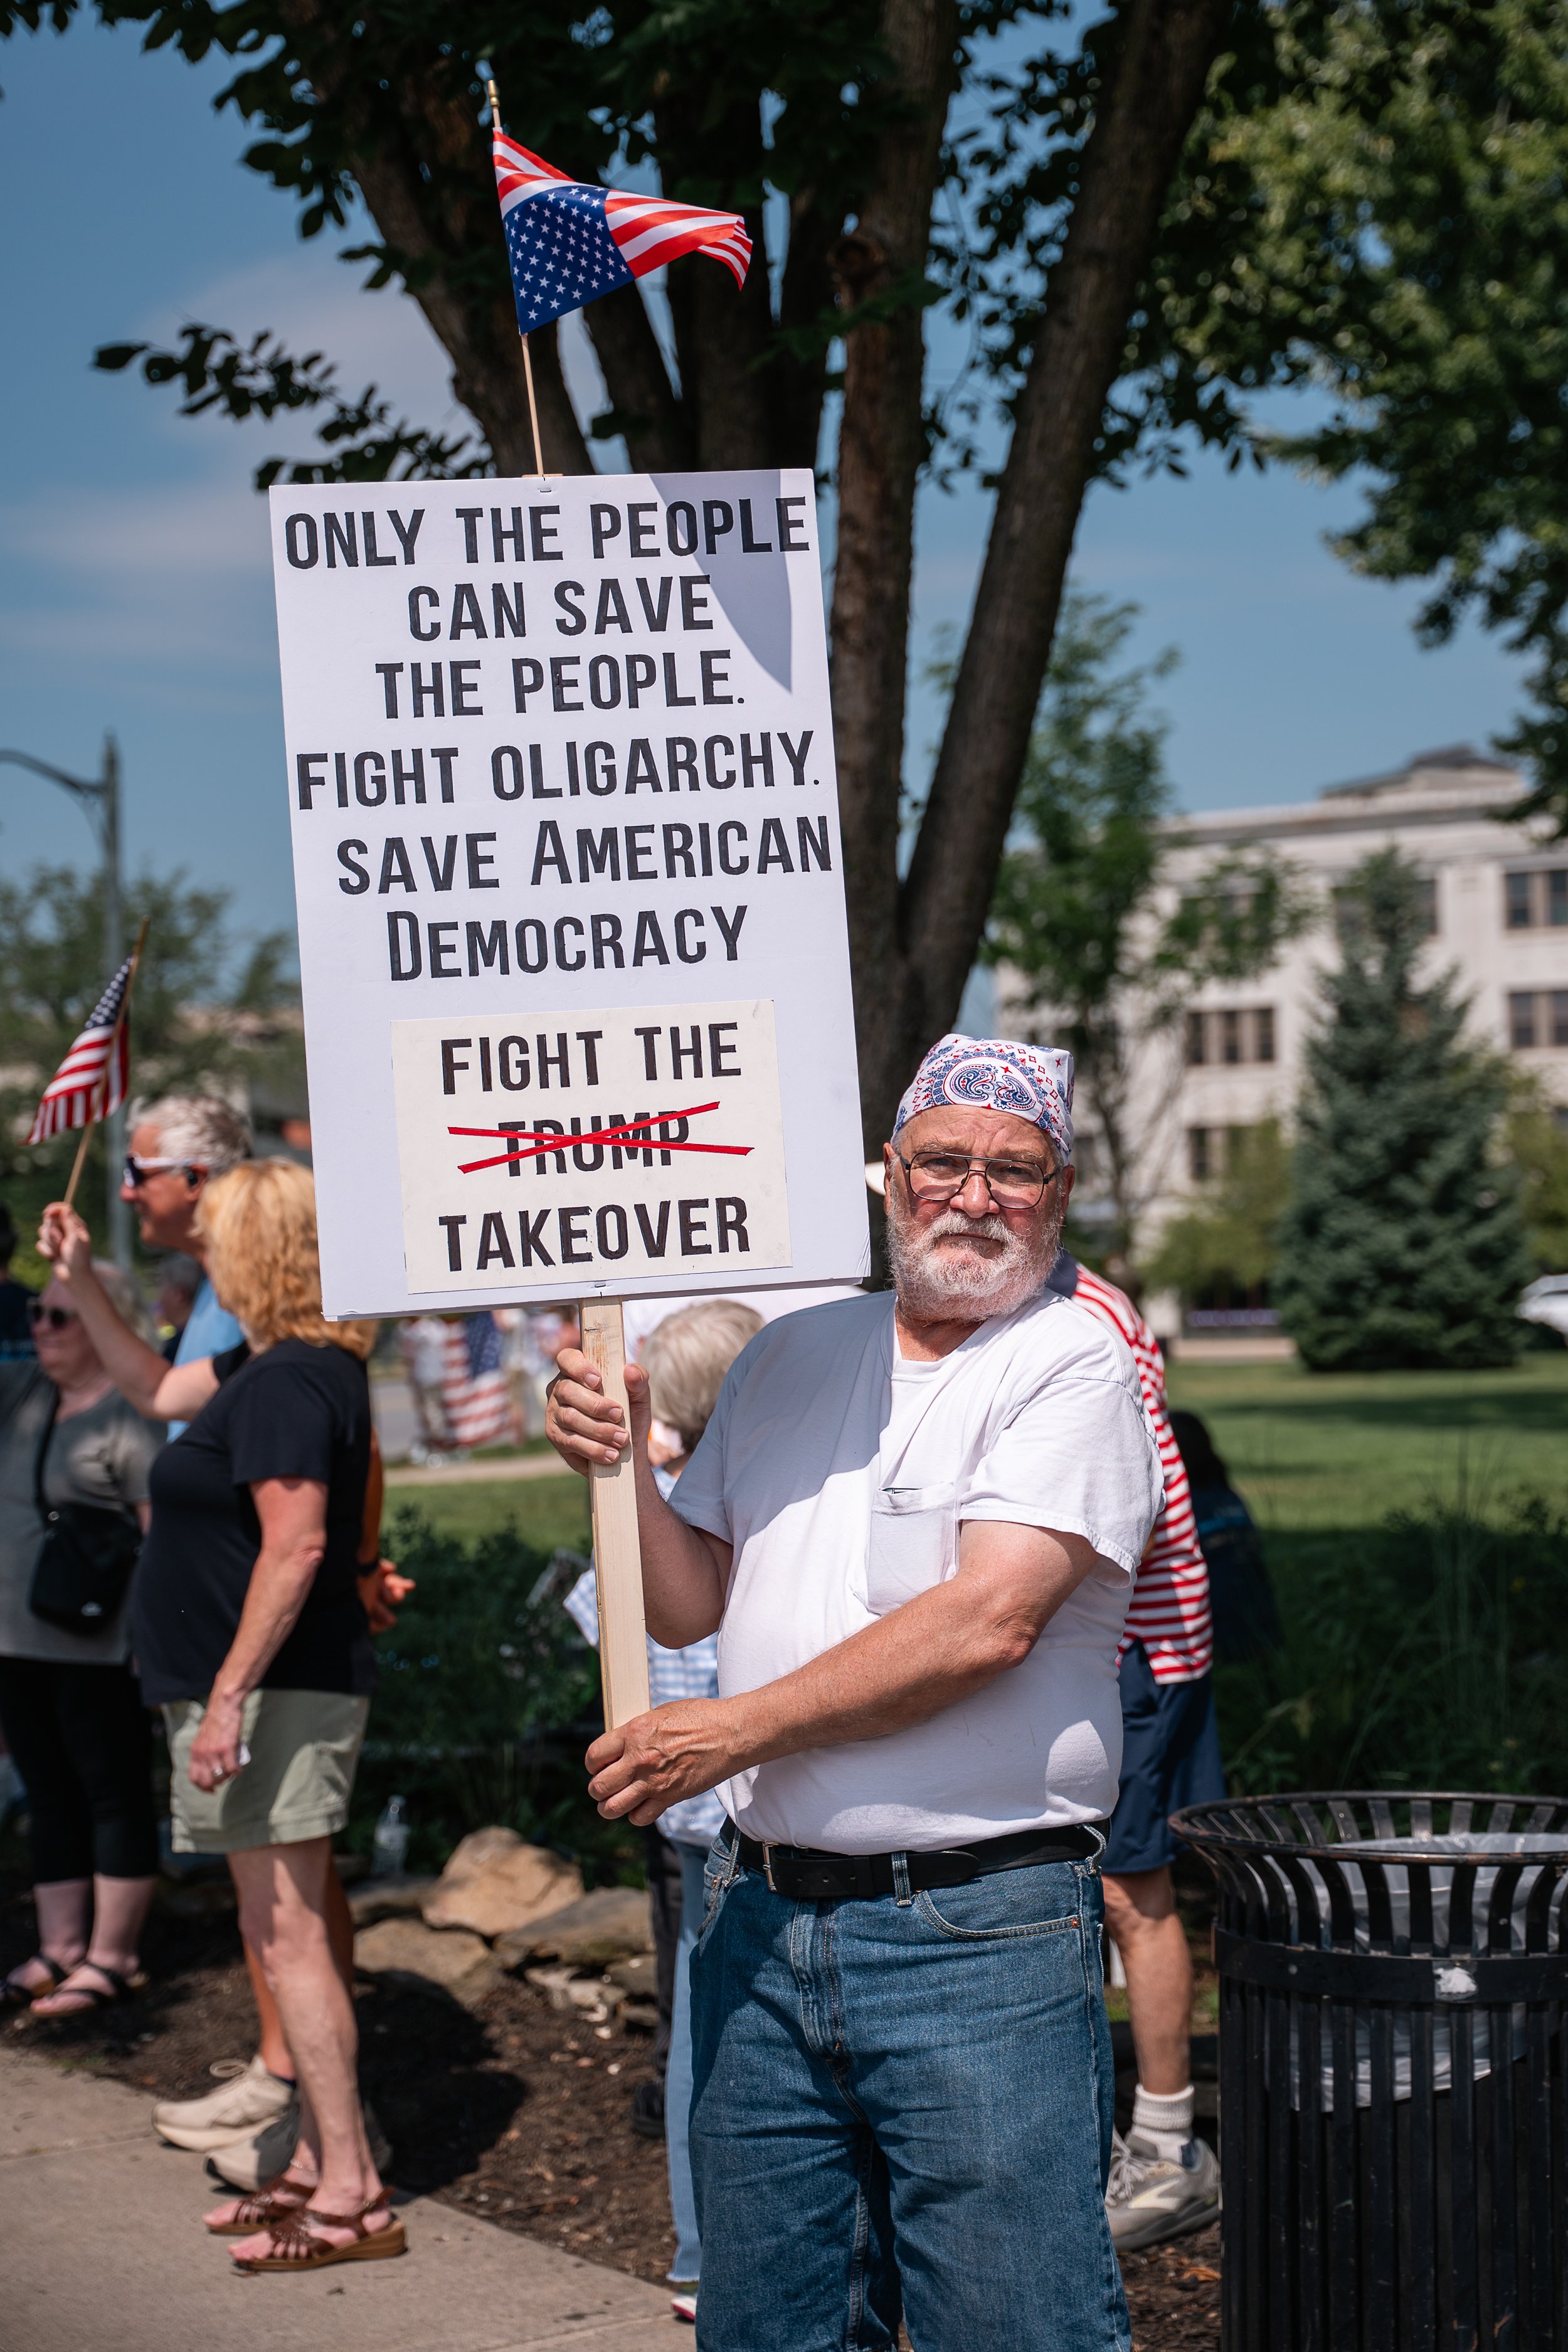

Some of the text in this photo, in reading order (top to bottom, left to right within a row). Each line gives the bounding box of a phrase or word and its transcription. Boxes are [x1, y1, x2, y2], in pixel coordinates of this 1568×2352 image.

[285, 497, 810, 569] ONLY THE PEOPLE
[408, 575, 713, 641] CAN SAVE
[376, 650, 744, 719] THE PEOPLE.
[297, 731, 820, 810] FIGHT OLIGARCHY.
[337, 816, 832, 894] SAVE AMERICAN
[387, 905, 747, 981] DEMOCRACY
[442, 1022, 741, 1094] FIGHT THE
[498, 1110, 689, 1177] TRUMP
[439, 1197, 750, 1271] TAKEOVER
